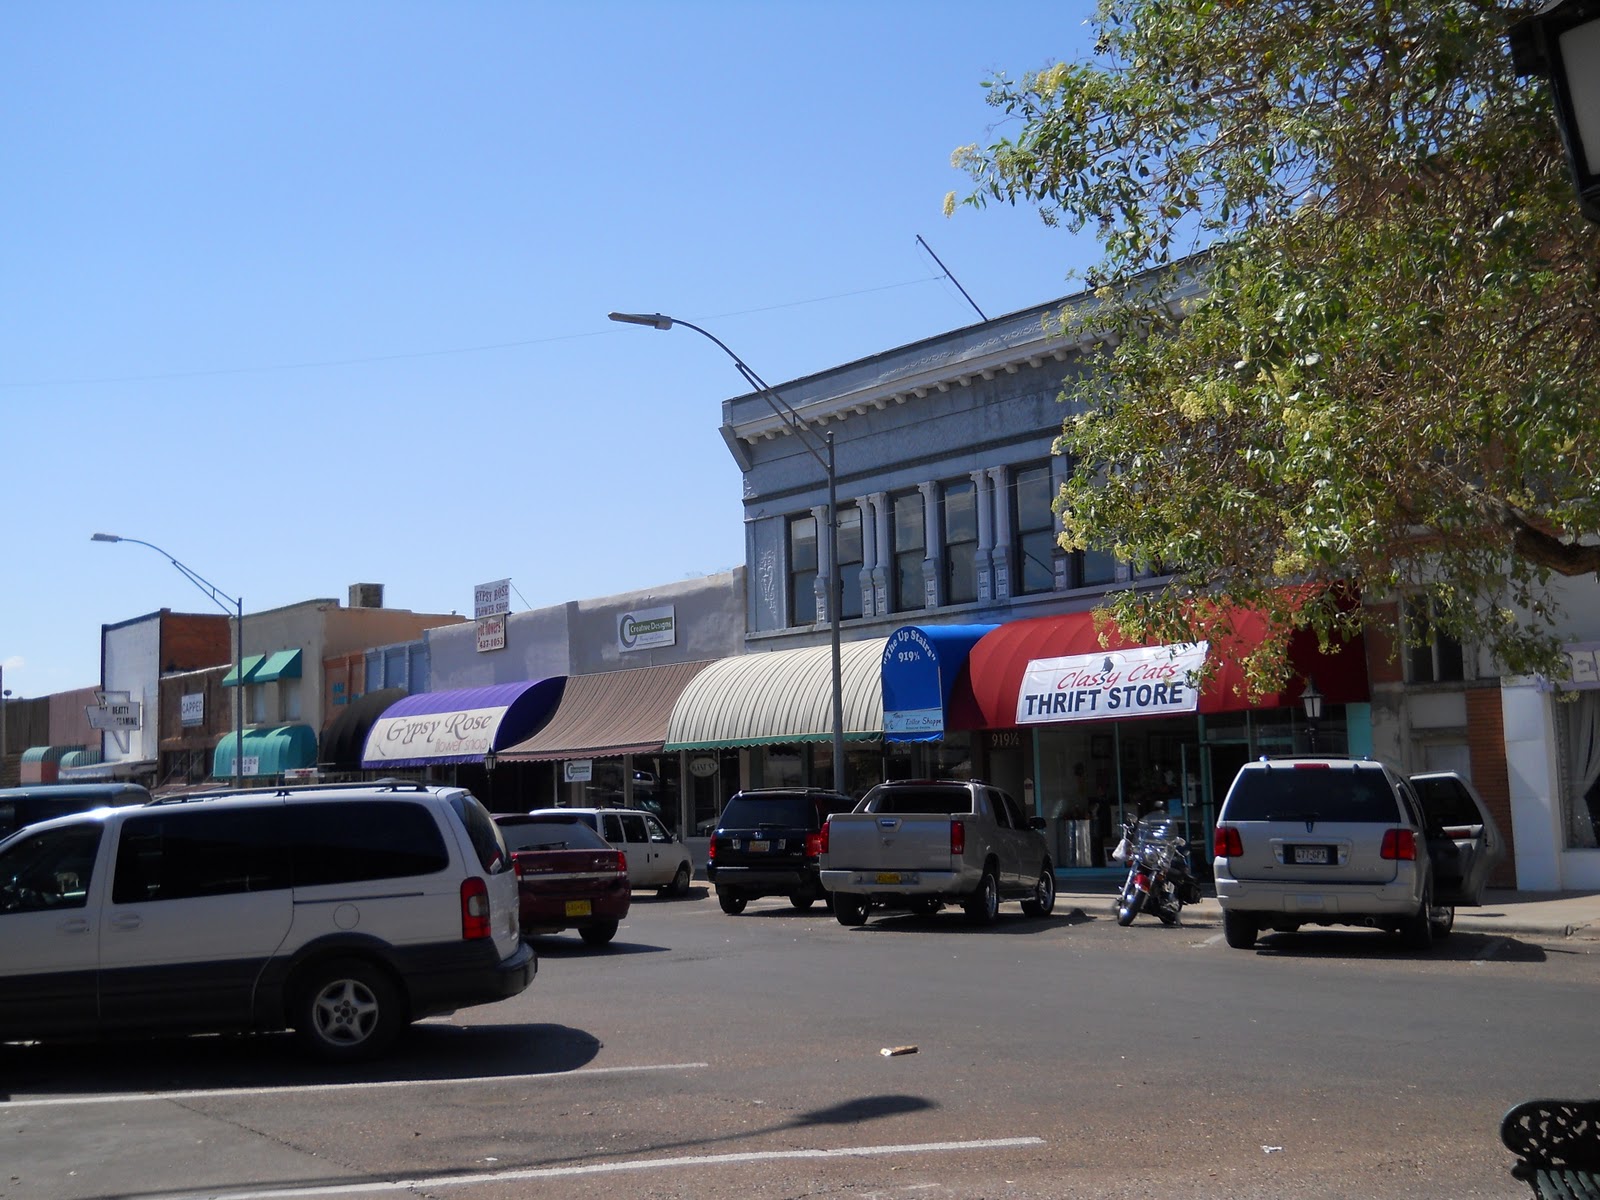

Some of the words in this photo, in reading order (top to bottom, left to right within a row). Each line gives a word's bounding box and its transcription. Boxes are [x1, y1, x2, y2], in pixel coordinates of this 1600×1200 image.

[475, 590, 493, 603] GYPSY
[494, 584, 509, 601] ROSE
[475, 604, 495, 618] FLOWER
[496, 602, 509, 614] SHOP
[630, 624, 650, 633] Creative
[651, 621, 672, 631] Designs
[897, 630, 910, 642] Up
[1057, 669, 1121, 690] Classy
[1127, 662, 1180, 682] Cats
[1025, 688, 1101, 716] THRIFT
[1107, 681, 1184, 710] STORE
[386, 719, 440, 745] Gypsy
[444, 713, 493, 740] Rose
[435, 740, 463, 753] flower
[464, 738, 487, 753] shop
